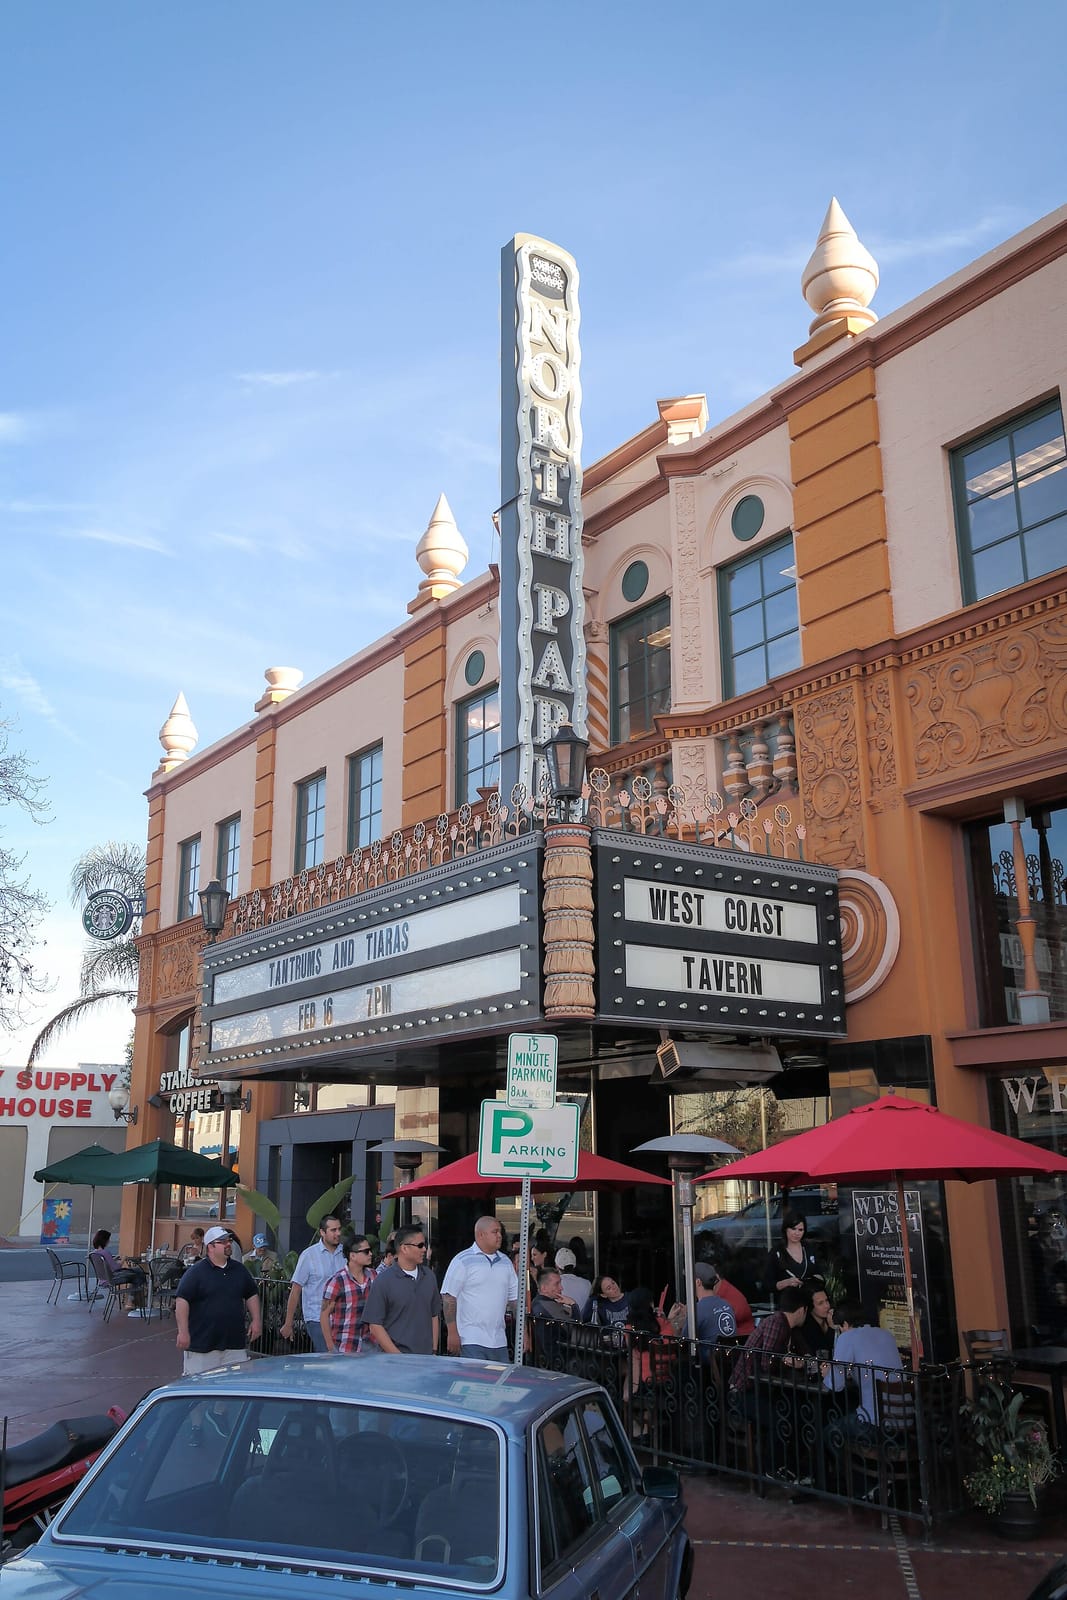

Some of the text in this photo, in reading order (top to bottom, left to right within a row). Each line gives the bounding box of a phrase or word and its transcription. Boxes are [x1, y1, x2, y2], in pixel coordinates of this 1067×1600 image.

[529, 301, 572, 562] NORTH
[531, 582, 575, 818] PAR
[86, 896, 123, 916] STARBUCKS
[649, 888, 784, 936] WEST COAST
[89, 926, 118, 936] COFFEE
[269, 922, 409, 987] TANTRUMS AND TIARAS
[683, 956, 763, 995] TAVERN
[298, 1002, 316, 1031] FEB
[366, 984, 392, 1017] 7PM
[528, 1038, 538, 1052] 15
[515, 1052, 550, 1067] MINUTE
[16, 1070, 118, 1092] SUPPLY
[160, 1068, 218, 1091] STARB
[511, 1068, 553, 1083] PARKING
[0, 1097, 92, 1118] HOUSE
[169, 1089, 211, 1113] COFFEE
[491, 1109, 566, 1157] PARKING
